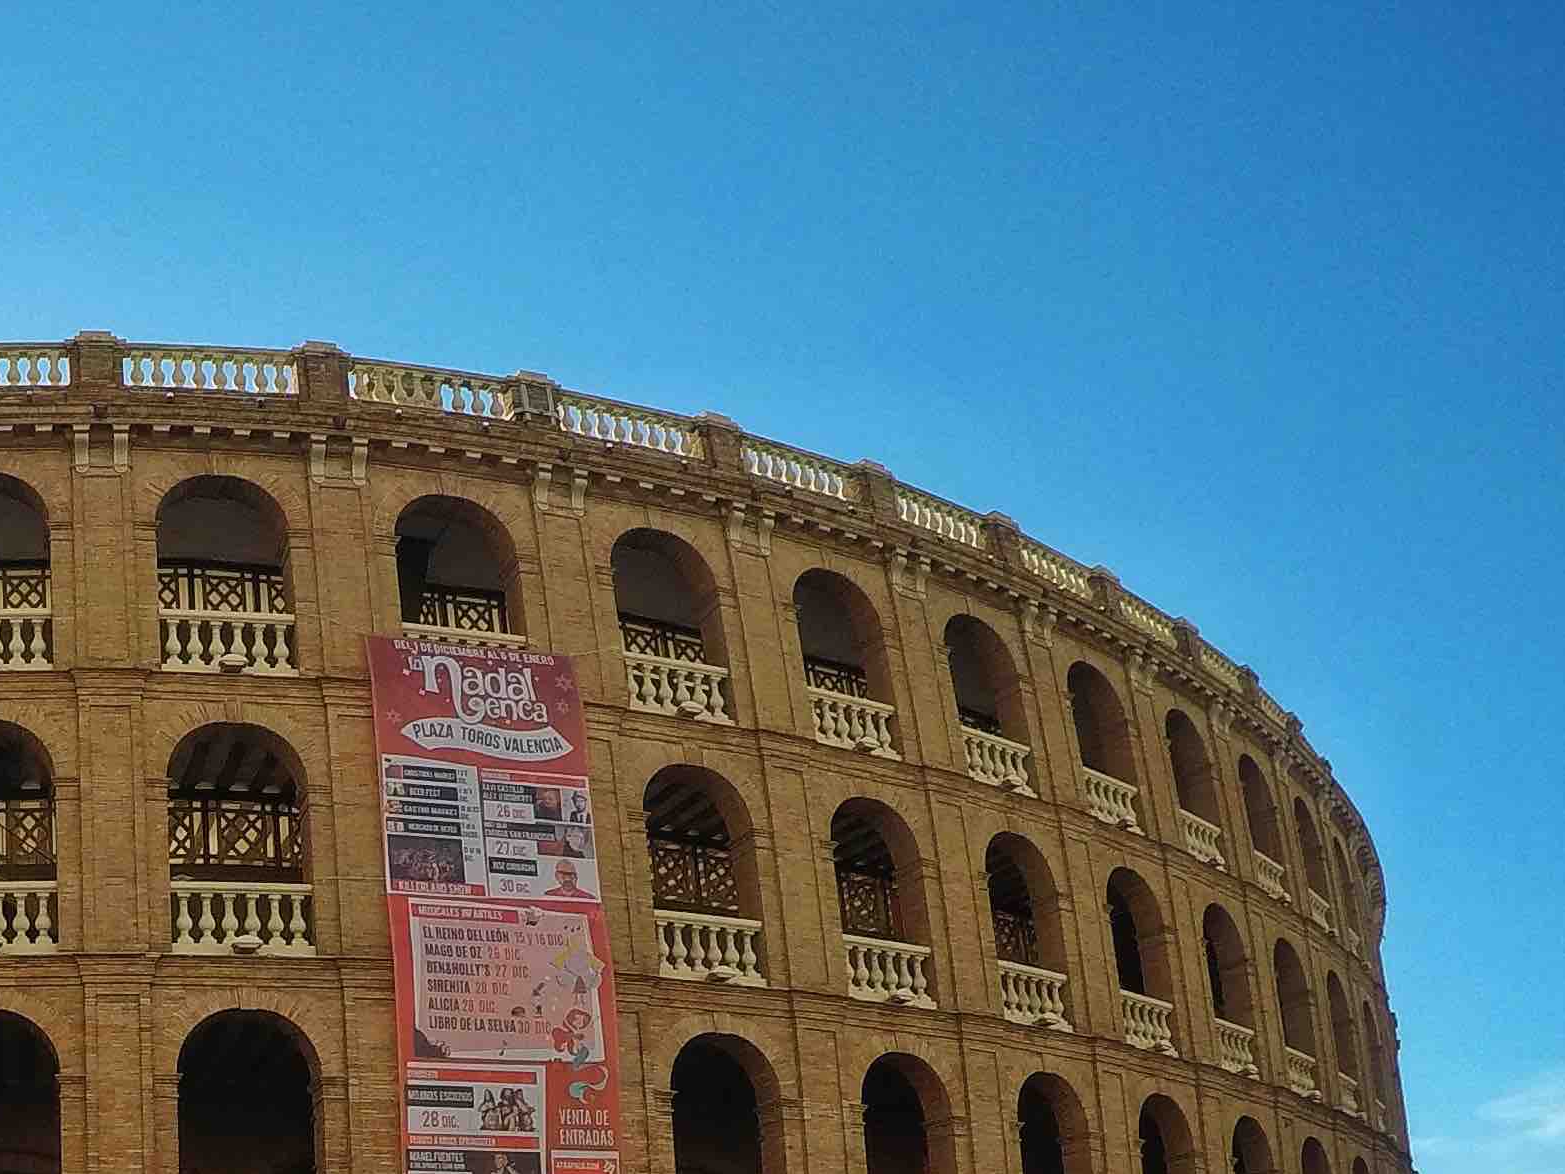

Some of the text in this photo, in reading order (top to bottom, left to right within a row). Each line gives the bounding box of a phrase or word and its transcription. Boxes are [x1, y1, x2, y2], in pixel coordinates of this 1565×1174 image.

[412, 722, 564, 754] PLAZA TOROS VALENCIA
[497, 803, 511, 818] 26
[499, 878, 515, 892] 30
[422, 925, 433, 939] EL
[435, 926, 465, 941] REINO
[466, 928, 485, 943] DEL
[425, 943, 454, 958] MAGO
[456, 945, 468, 958] DE
[470, 945, 483, 960] OZ
[427, 979, 471, 995] SIRENITA
[428, 997, 460, 1013] ALICIA
[429, 1016, 457, 1030] LIBRO
[459, 1017, 472, 1031] DE
[473, 1017, 485, 1031] LA
[486, 1019, 516, 1033] SELVA
[422, 1110, 439, 1127] 28
[559, 1108, 610, 1126] VENTA DE
[560, 1128, 615, 1147] ENTRADAS
